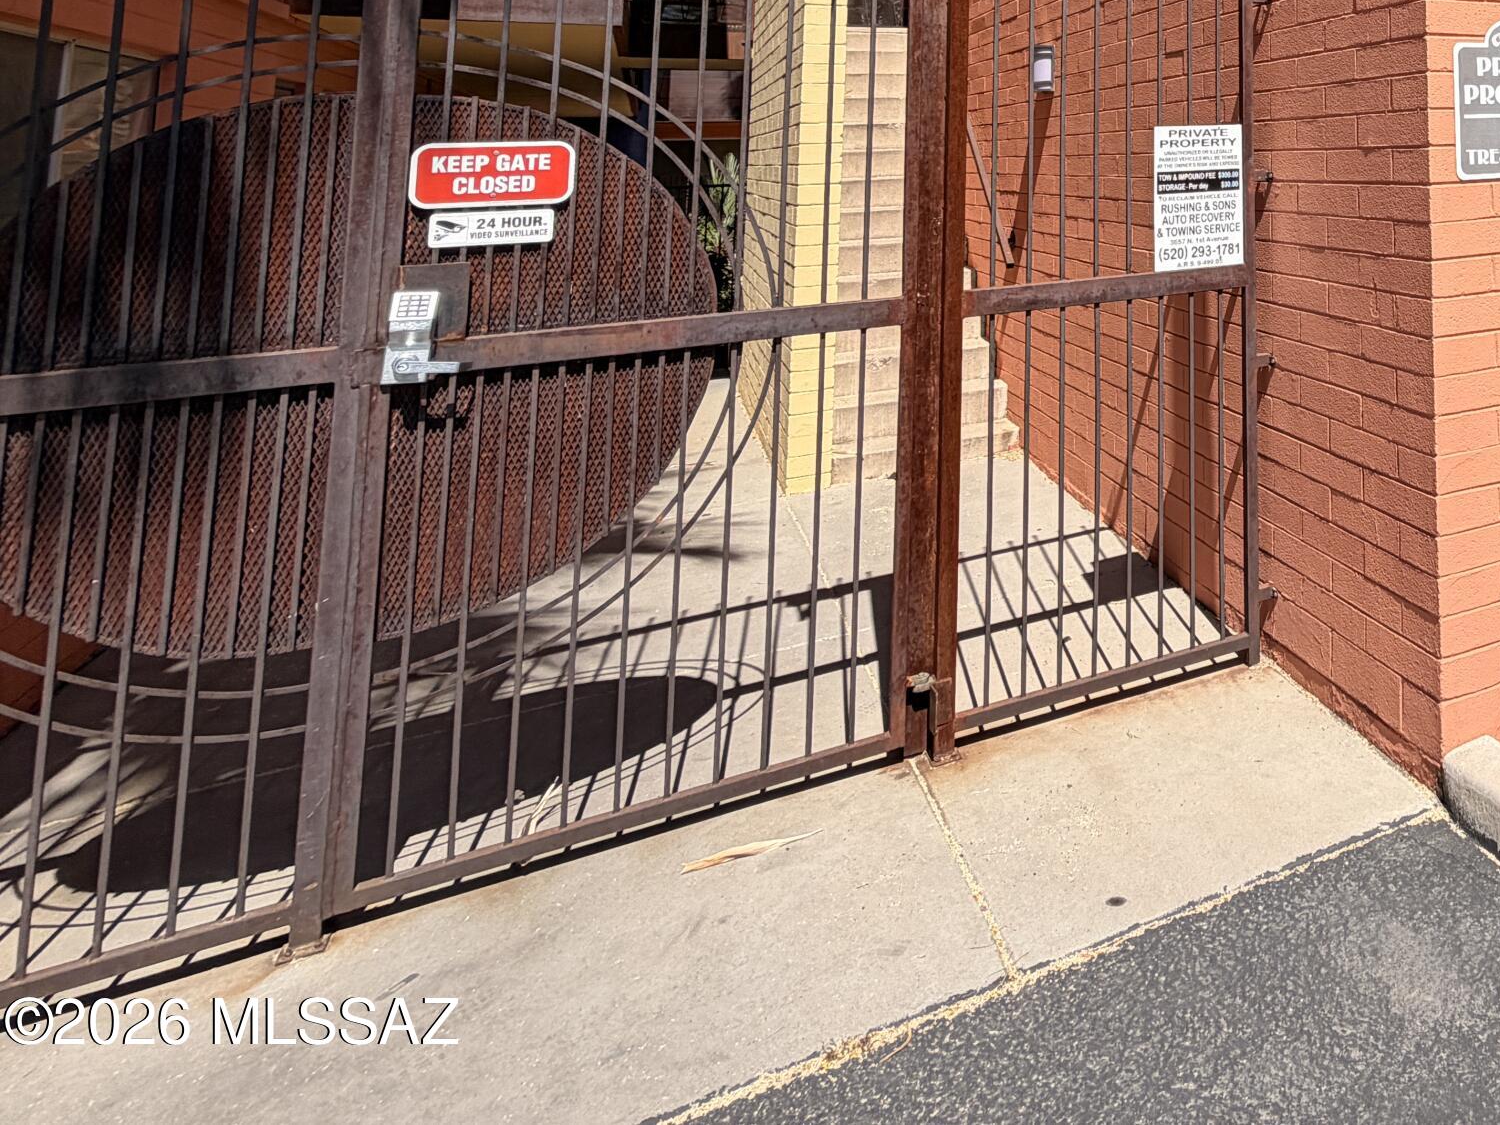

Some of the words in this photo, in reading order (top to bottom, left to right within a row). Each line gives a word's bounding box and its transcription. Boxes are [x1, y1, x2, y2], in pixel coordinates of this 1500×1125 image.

[1168, 128, 1229, 137] PRIVATE
[1160, 138, 1237, 148] PROPERTY
[431, 155, 490, 173] KEEP
[495, 153, 552, 172] GATE
[1178, 172, 1205, 180] IMPOUND
[1205, 171, 1217, 179] FEE
[452, 175, 536, 195] CLOSED
[1199, 182, 1209, 190] day
[1160, 202, 1202, 214] RUSHING
[1204, 201, 1211, 211] &
[1212, 200, 1237, 210] SONS
[476, 218, 496, 230] 24
[1162, 214, 1187, 226] AUTO
[1189, 211, 1236, 223] RECOVERY
[470, 229, 493, 239] VIDEO
[494, 228, 549, 238] SURVEILLANCE
[1157, 228, 1163, 238] &
[1166, 225, 1203, 237] TOWING
[1204, 222, 1241, 234] SERVICE
[1159, 246, 1188, 262] (520)
[1191, 242, 1240, 259] 293-1781
